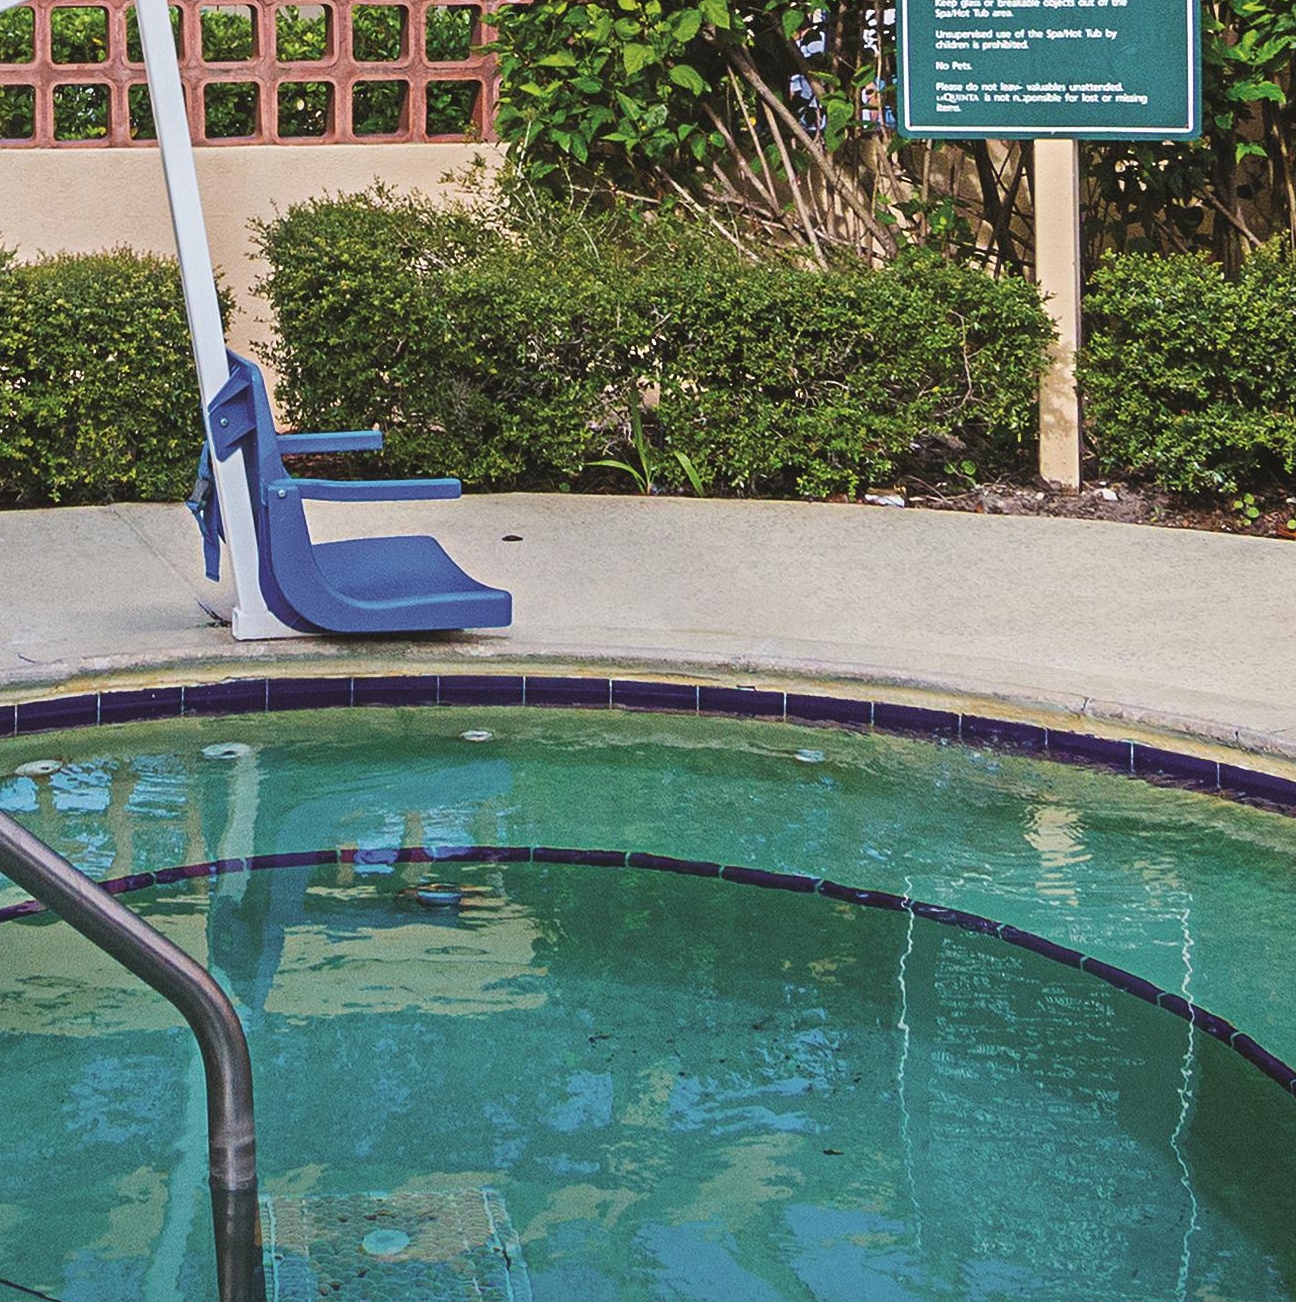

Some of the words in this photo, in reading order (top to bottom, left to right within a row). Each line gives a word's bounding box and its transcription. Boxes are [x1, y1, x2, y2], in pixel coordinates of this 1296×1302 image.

[983, 0, 995, 7] or
[934, 8, 970, 19] Spa/Hot
[972, 8, 990, 18] Tub
[991, 9, 1014, 18] area.
[995, 31, 1012, 39] use
[1013, 28, 1025, 39] of
[1027, 29, 1044, 39] the
[1045, 28, 1083, 40] Spa/Hot
[1085, 28, 1103, 38] Tub
[1104, 28, 1118, 40] by
[934, 39, 970, 50] children
[972, 40, 980, 49] is
[935, 61, 950, 70] No
[951, 60, 973, 71] Pets.
[935, 81, 964, 92] Please
[965, 82, 979, 92] do
[981, 82, 998, 92] not
[983, 92, 992, 102] is
[993, 93, 1010, 102] not
[1064, 92, 1079, 103] for
[1081, 92, 1099, 103] lost
[1100, 94, 1113, 103] or
[1115, 93, 1148, 105] missing
